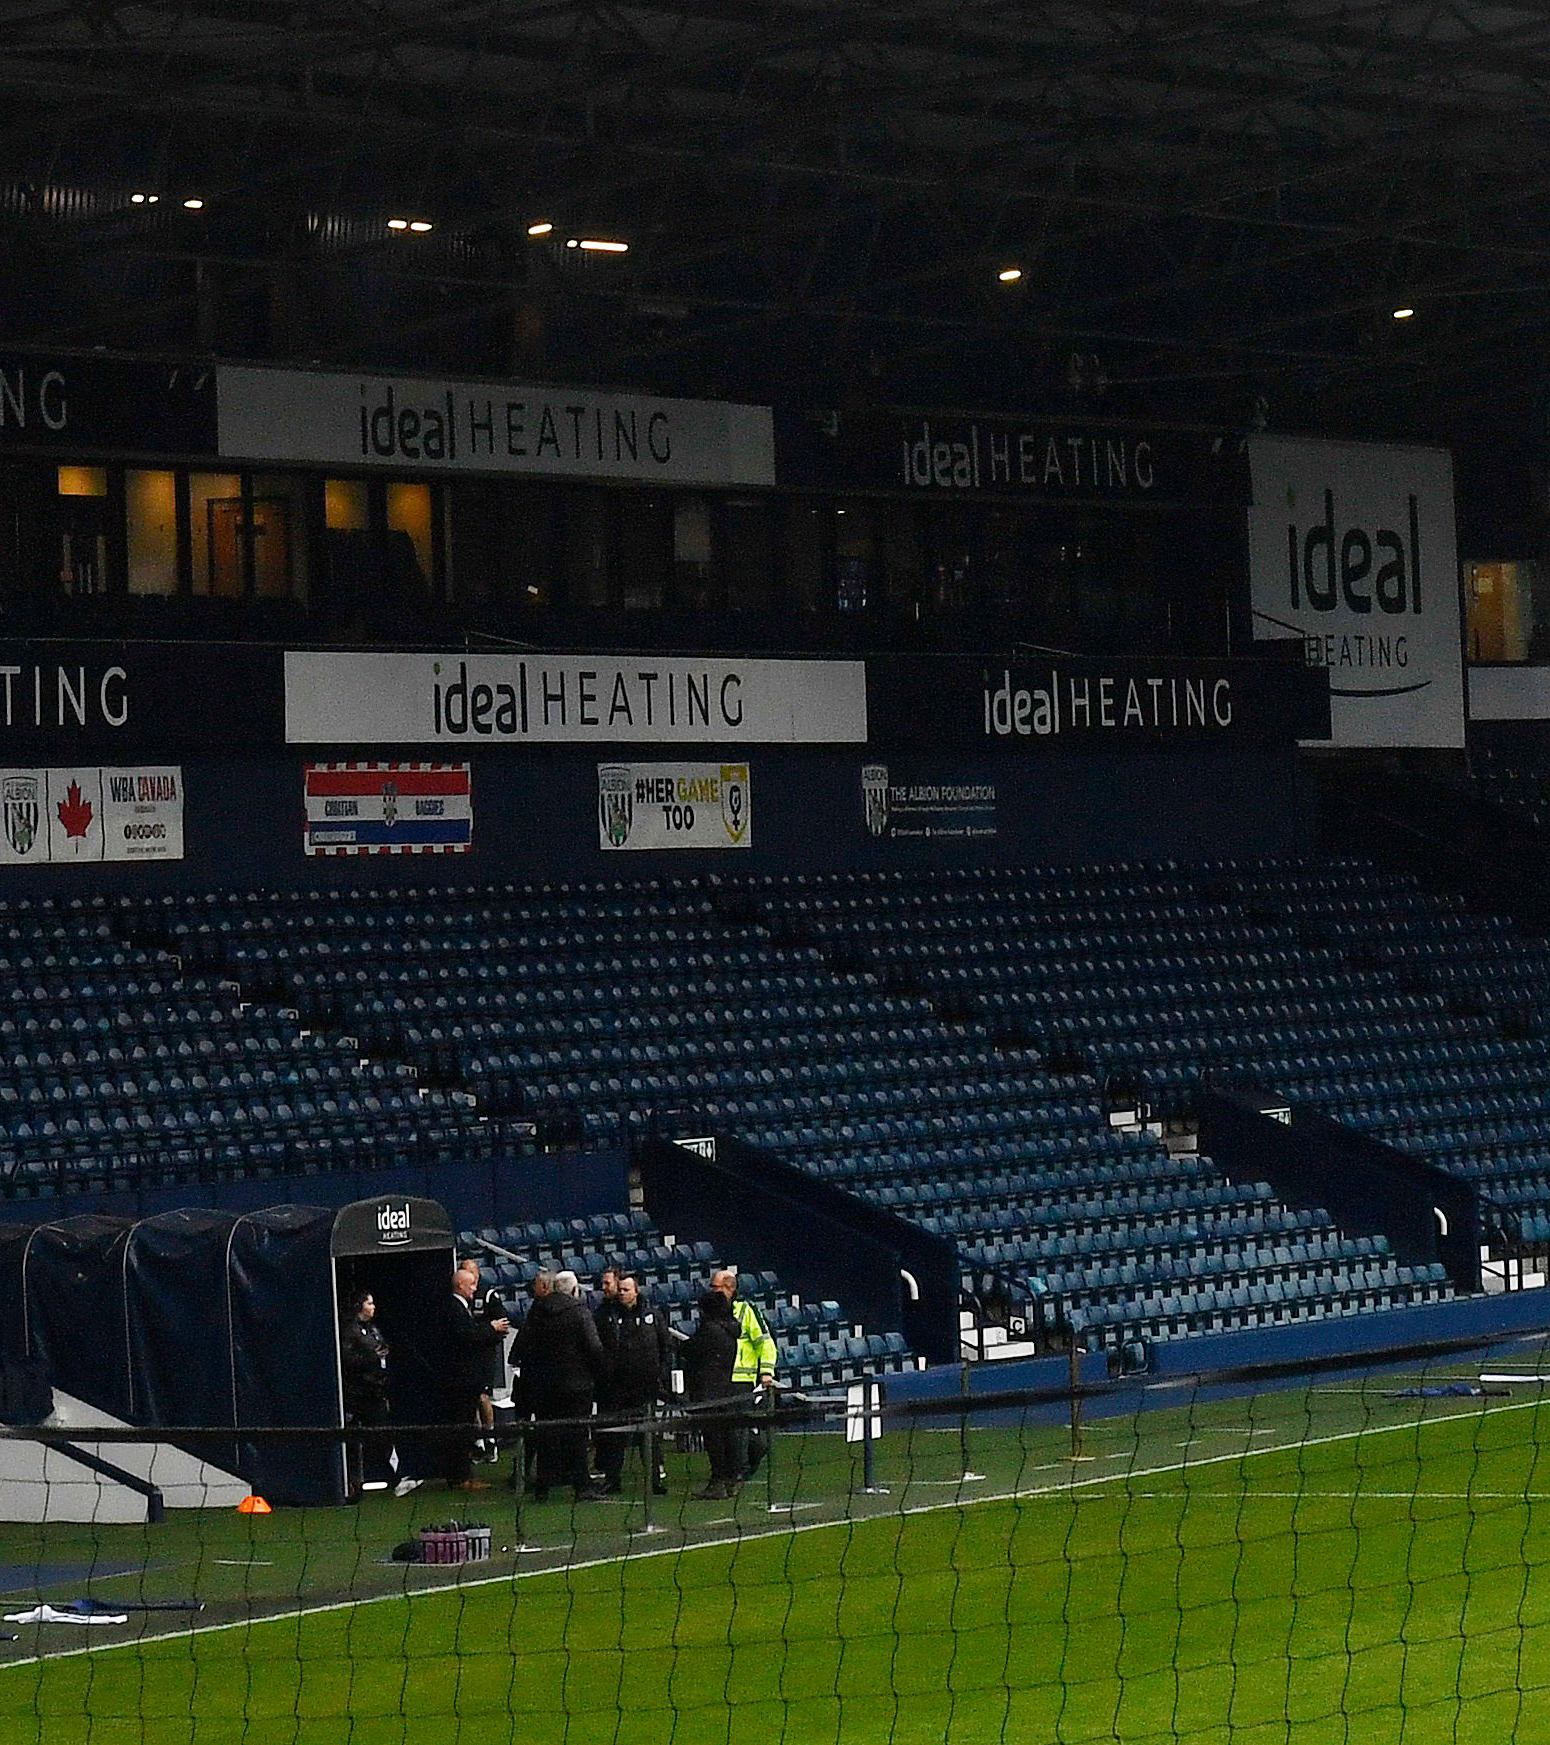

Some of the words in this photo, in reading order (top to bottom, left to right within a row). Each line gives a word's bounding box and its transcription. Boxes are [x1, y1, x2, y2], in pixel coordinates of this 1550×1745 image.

[358, 384, 456, 460] ideal
[468, 398, 674, 465] HEATING
[902, 420, 980, 489] ideal
[990, 431, 1155, 489] HEATING
[1286, 482, 1423, 615] ideal
[1304, 632, 1409, 669] HEATING
[432, 660, 529, 736] ideal
[542, 670, 746, 728] HEATING
[983, 668, 1061, 735] ideal
[1070, 676, 1234, 727] HEATING
[109, 776, 136, 803] WBA
[137, 775, 177, 803] CANADA
[635, 777, 676, 804] #HER
[677, 777, 719, 803] GAME
[889, 785, 907, 801] THE
[908, 785, 940, 801] ALBION
[941, 785, 996, 800] FOUNDATION
[662, 804, 695, 831] TOO
[377, 1202, 411, 1231] ideal
